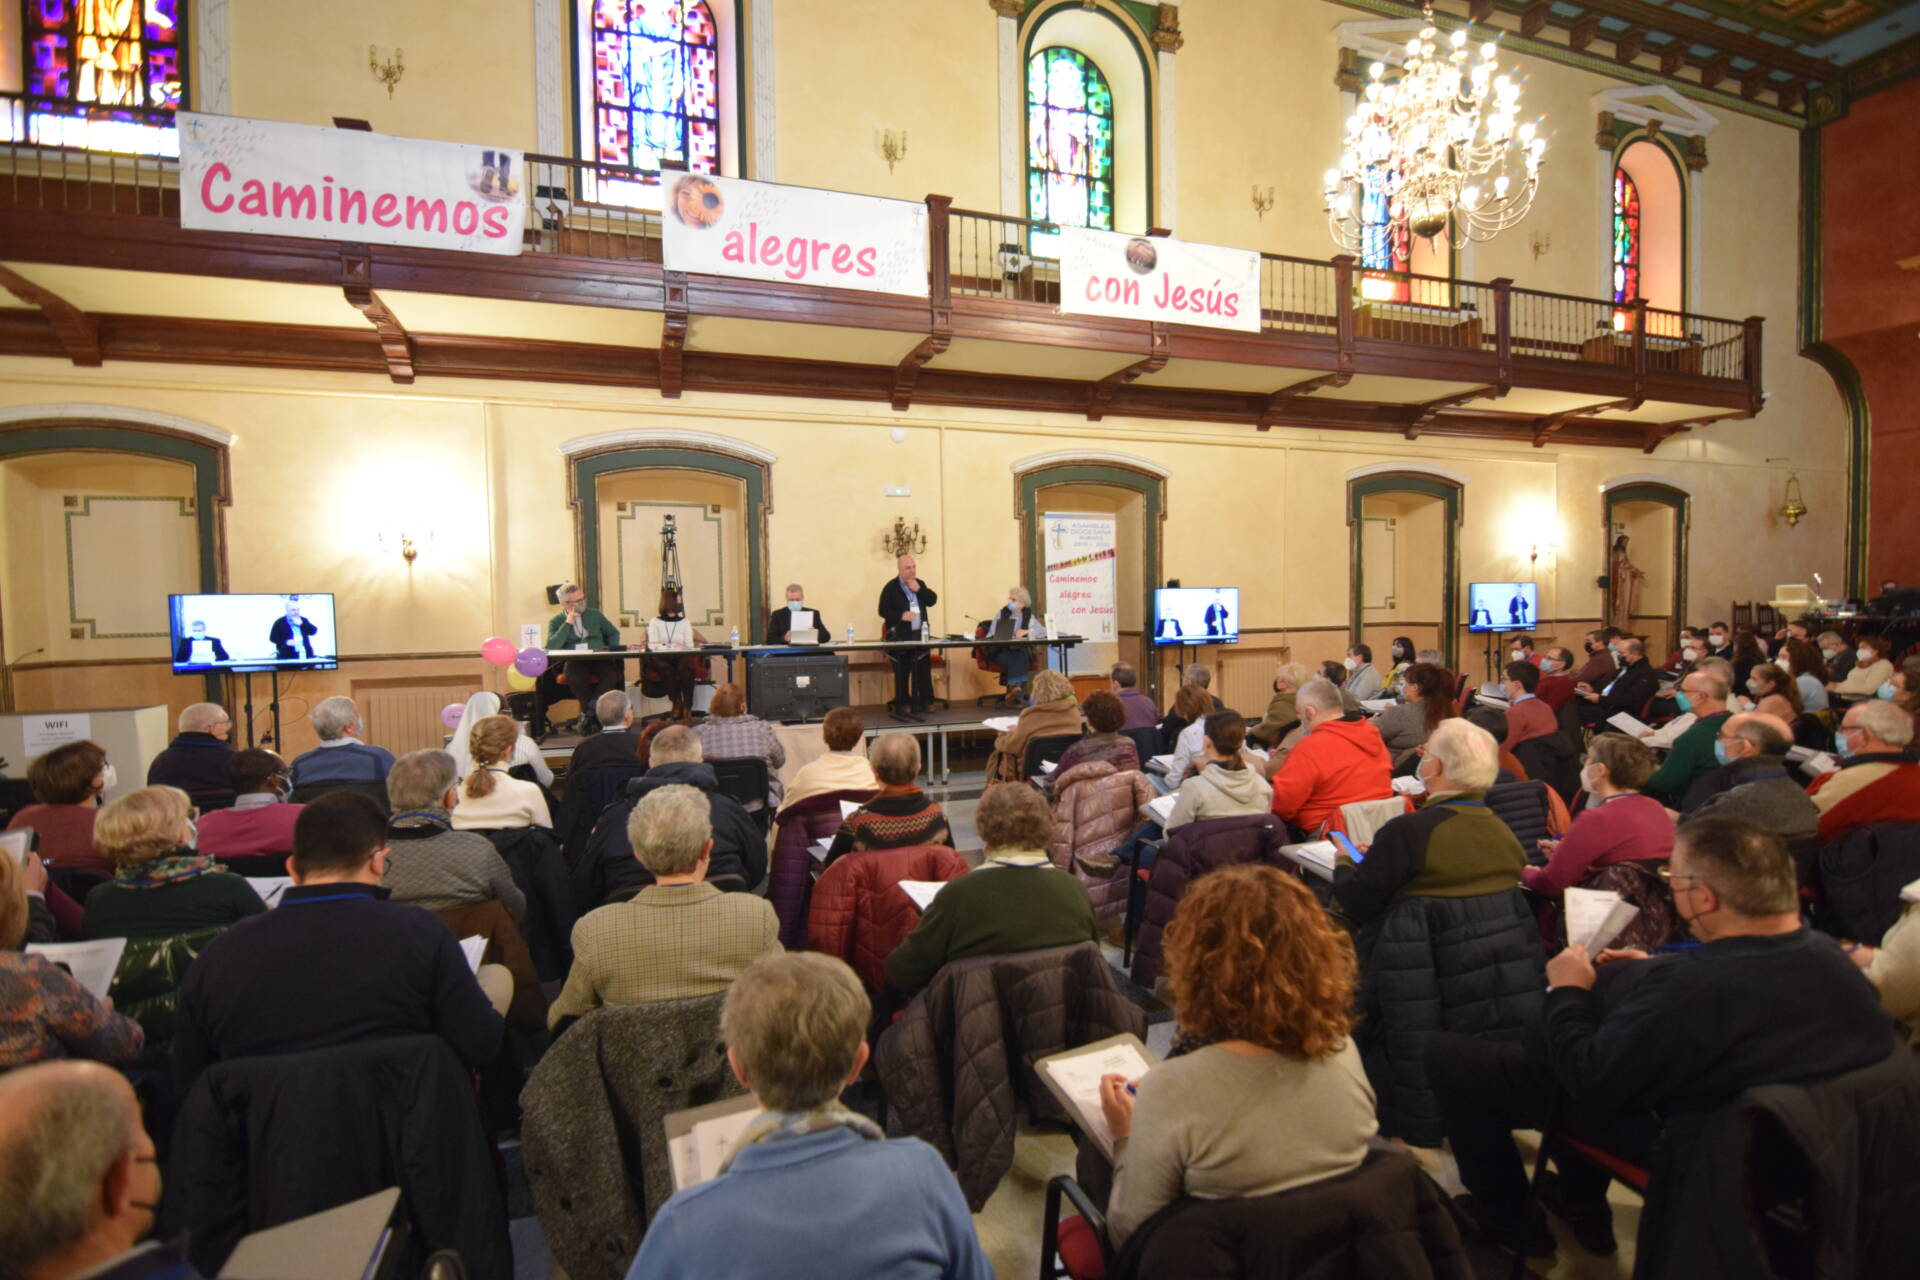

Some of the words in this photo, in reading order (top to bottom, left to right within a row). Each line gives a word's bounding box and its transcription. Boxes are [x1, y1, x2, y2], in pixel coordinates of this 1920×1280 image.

[201, 162, 508, 238] Caminemos
[722, 222, 877, 280] alegres
[1085, 275, 1140, 306] con
[1154, 272, 1239, 318] Jesús
[1049, 574, 1098, 584] Caminemos
[1059, 589, 1092, 601] alegres
[1071, 607, 1086, 615] con
[45, 720, 68, 729] WIFI
